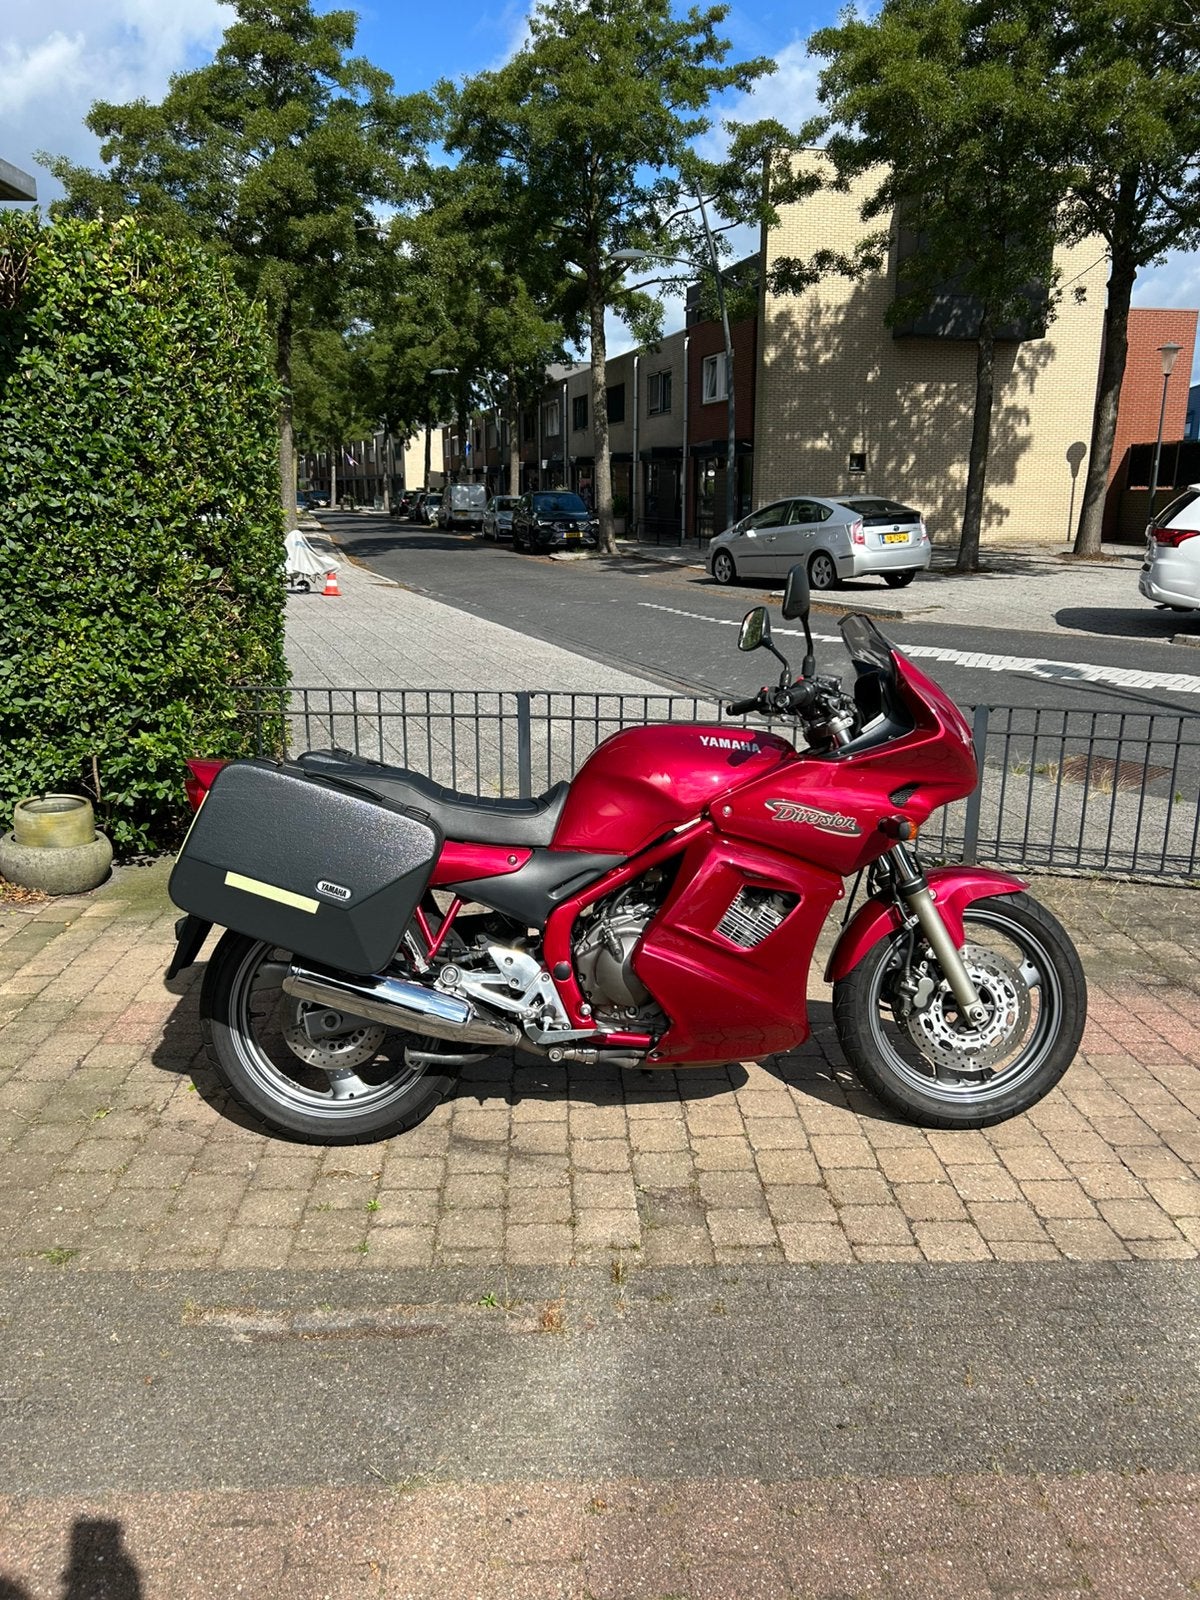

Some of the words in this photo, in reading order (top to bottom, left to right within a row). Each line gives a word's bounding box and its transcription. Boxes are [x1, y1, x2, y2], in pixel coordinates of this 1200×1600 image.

[699, 735, 761, 753] YAMAHA
[772, 806, 857, 830] Diversion
[321, 882, 347, 897] YAMAHA
